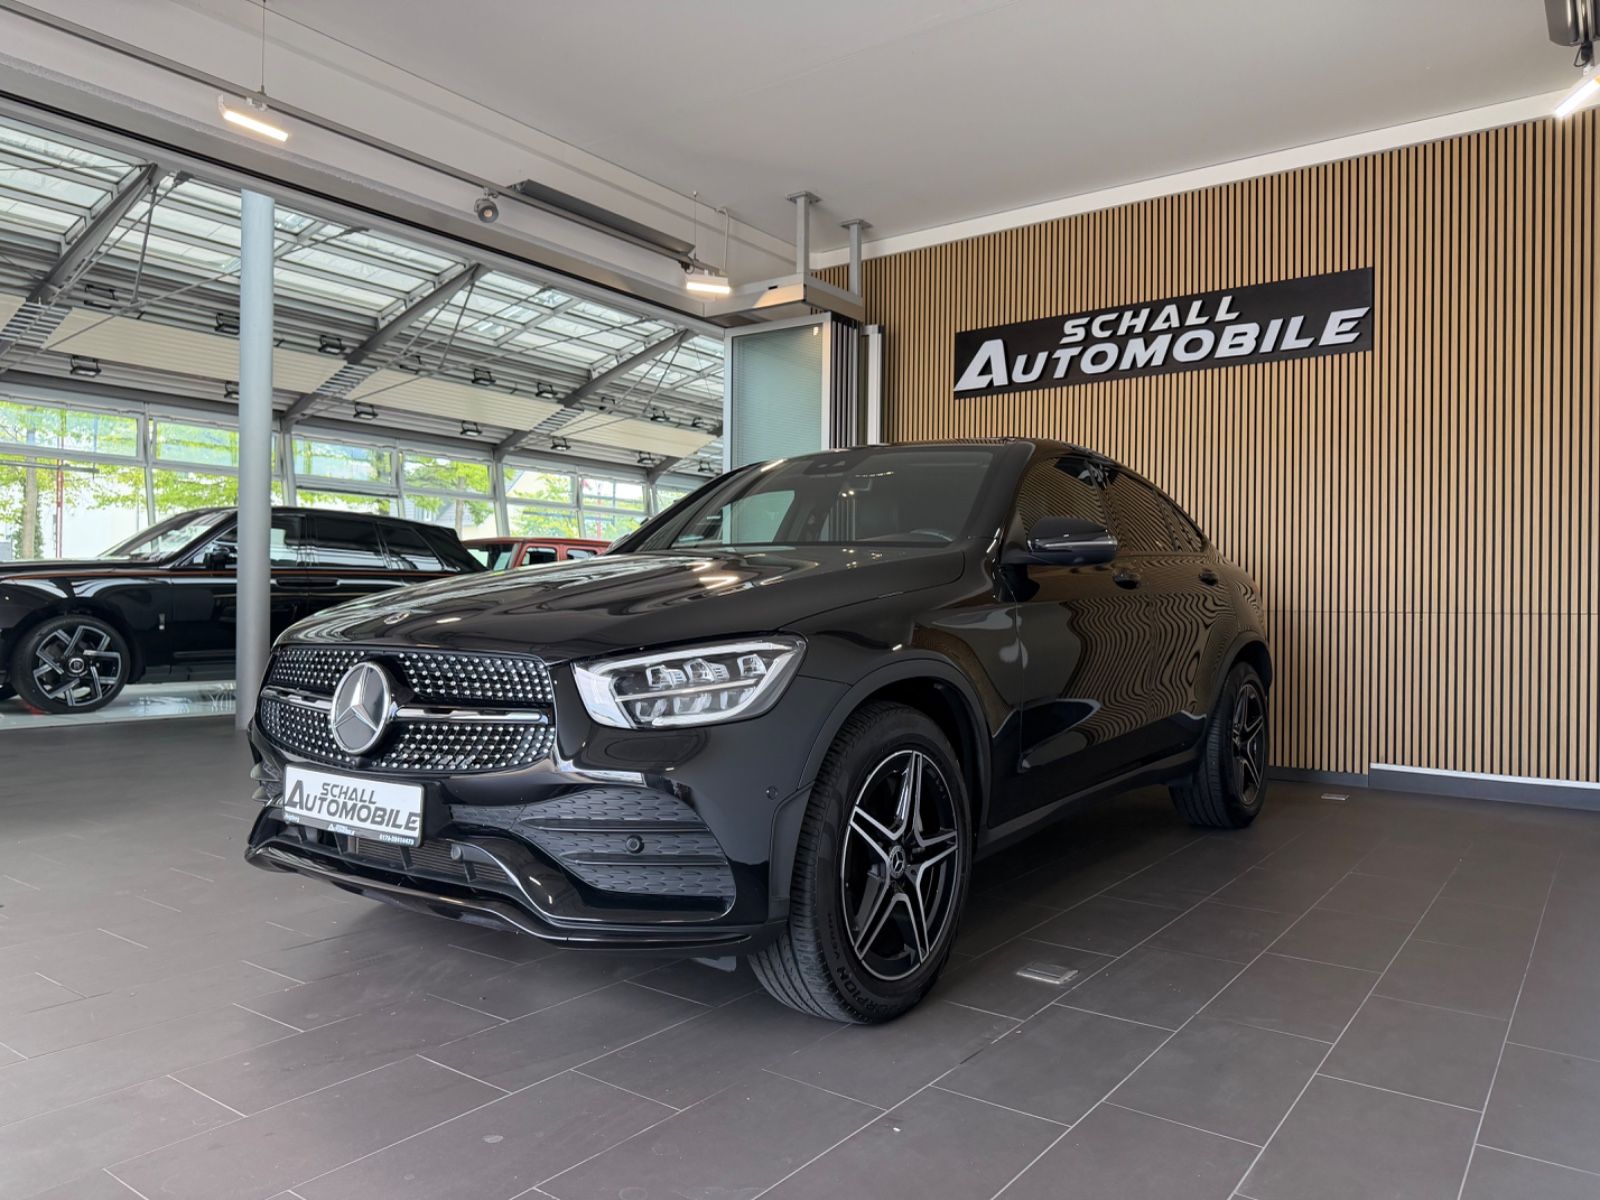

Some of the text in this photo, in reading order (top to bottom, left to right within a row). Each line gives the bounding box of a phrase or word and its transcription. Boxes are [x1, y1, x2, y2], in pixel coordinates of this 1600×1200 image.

[1059, 295, 1243, 344] SCHALL
[953, 306, 1371, 393] AUTOMOBILE
[286, 780, 420, 831] AUTOMOBILE
[320, 782, 377, 804] SCHALL
